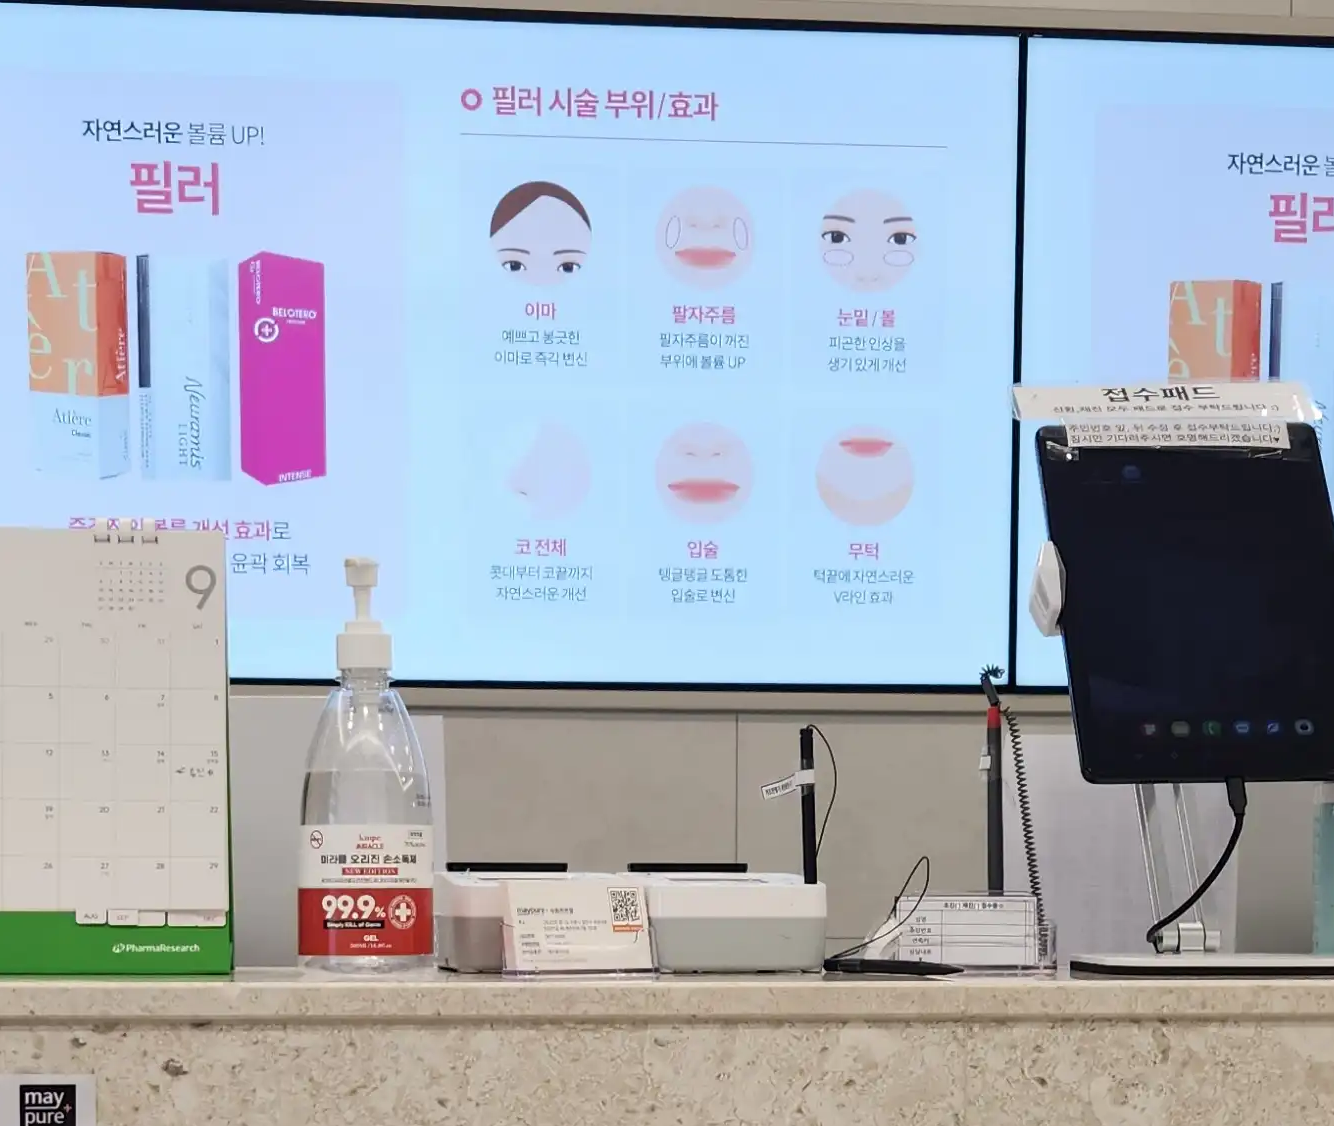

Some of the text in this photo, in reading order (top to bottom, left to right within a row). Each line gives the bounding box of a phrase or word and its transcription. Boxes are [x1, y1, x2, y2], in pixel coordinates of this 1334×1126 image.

[493, 86, 719, 121] 필러 시술 부위/효과
[83, 119, 264, 145] 자연스러운 볼륨 UP!
[1228, 153, 1320, 176] 자연스러운
[130, 160, 219, 216] 필러
[272, 307, 317, 319] BELOTERO
[525, 302, 556, 320] 이마
[672, 305, 735, 324] 팔자주름
[837, 309, 895, 328] 눈밑 볼
[725, 334, 749, 348] 꺼진
[829, 336, 866, 351] 피곤한
[495, 350, 587, 366] 이마로 즉각 변신
[660, 354, 697, 368] 부위에
[729, 356, 747, 369] UP
[827, 357, 906, 373] 생기 있게 개선
[1102, 386, 1220, 402] 접수패드
[184, 376, 205, 469] Neuramis
[178, 424, 189, 465] LIGHT
[278, 471, 312, 482] INTENSE
[234, 520, 291, 541] 효과로
[515, 539, 566, 556] 코 전체
[687, 541, 719, 559] 입술
[849, 543, 879, 560] 무턱
[231, 552, 310, 575] 윤곽 회복
[851, 569, 915, 584] 자연스러운
[185, 565, 216, 610] 9
[497, 586, 586, 601] 자연스러운 개선
[834, 590, 892, 605] V라인 효과
[351, 854, 379, 864] 오리진
[322, 895, 386, 919] 99.9%
[126, 943, 200, 954] PharmaResearch
[25, 1091, 64, 1108] may
[25, 1109, 64, 1126] pure
